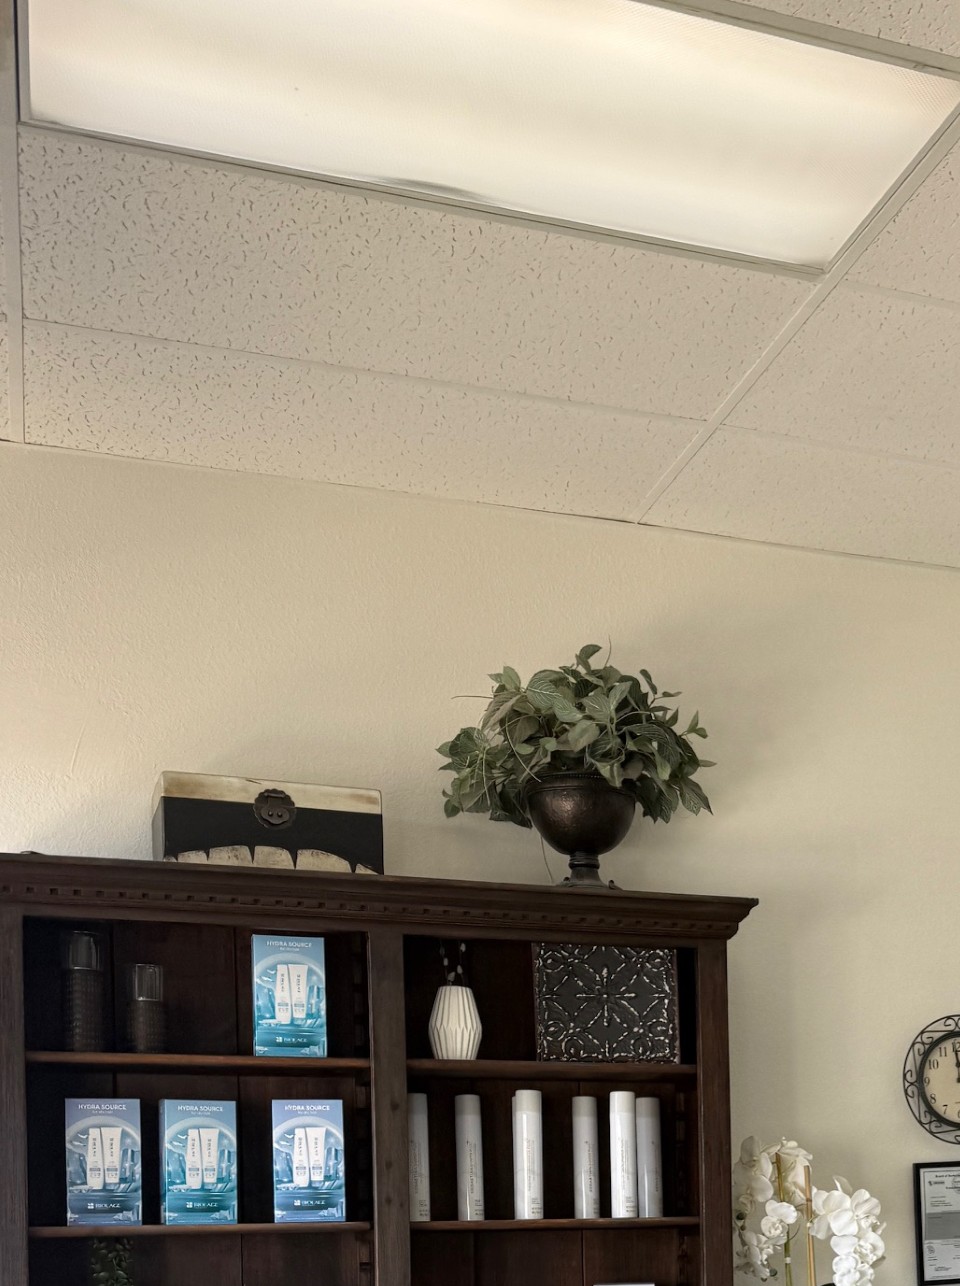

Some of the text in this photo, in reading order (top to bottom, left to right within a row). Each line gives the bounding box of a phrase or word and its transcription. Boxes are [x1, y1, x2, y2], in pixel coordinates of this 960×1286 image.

[938, 1046, 948, 1057] 11
[928, 1059, 939, 1070] 10
[924, 1076, 930, 1086] 9
[930, 1093, 936, 1104] 8
[942, 1104, 948, 1114] 7
